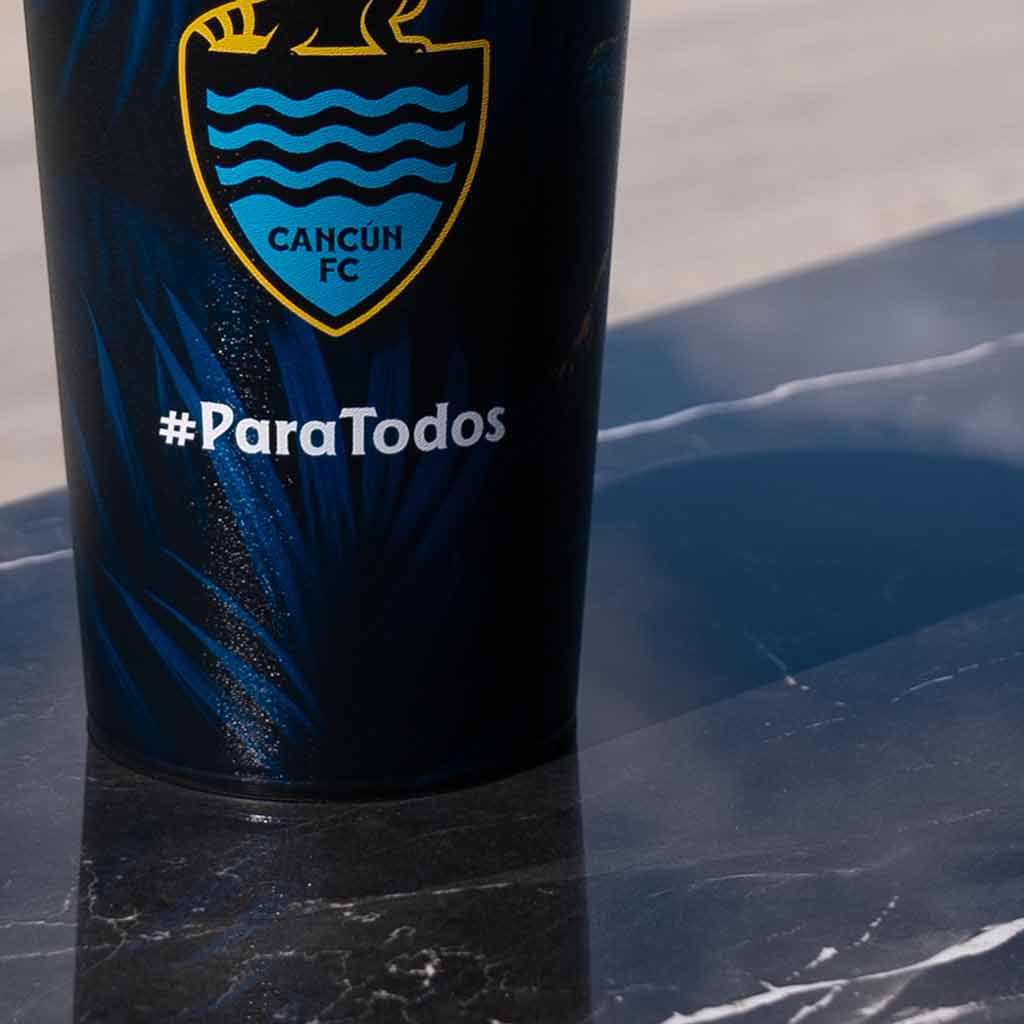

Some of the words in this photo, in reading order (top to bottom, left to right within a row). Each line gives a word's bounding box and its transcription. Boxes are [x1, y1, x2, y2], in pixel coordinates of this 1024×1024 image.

[268, 221, 403, 253] CANCÚN
[319, 257, 361, 283] FC
[159, 401, 506, 456] #ParaTodos
